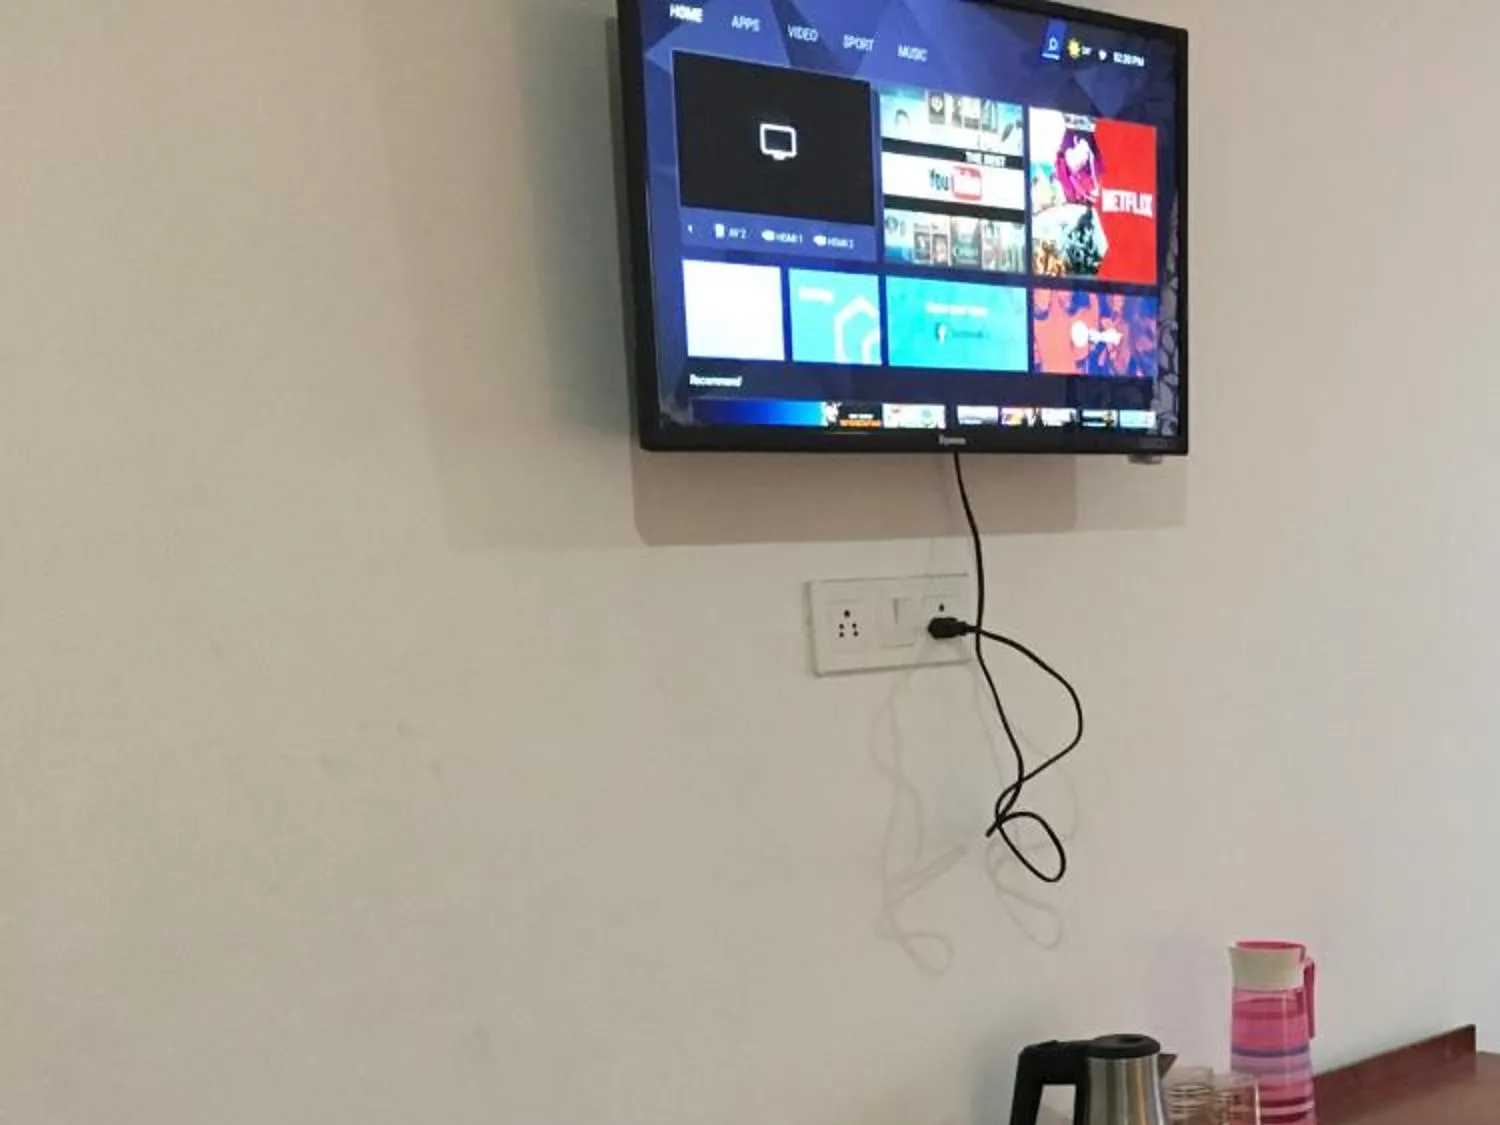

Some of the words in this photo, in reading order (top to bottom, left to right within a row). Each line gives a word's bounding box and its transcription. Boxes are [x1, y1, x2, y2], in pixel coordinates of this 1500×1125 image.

[669, 3, 703, 24] HOME
[731, 15, 760, 33] APPS
[787, 23, 819, 43] VIDEO
[843, 33, 874, 52] SPORT
[898, 43, 928, 62] MUSIC
[1102, 188, 1153, 218] NETFLIX
[688, 372, 743, 388] Recommend
